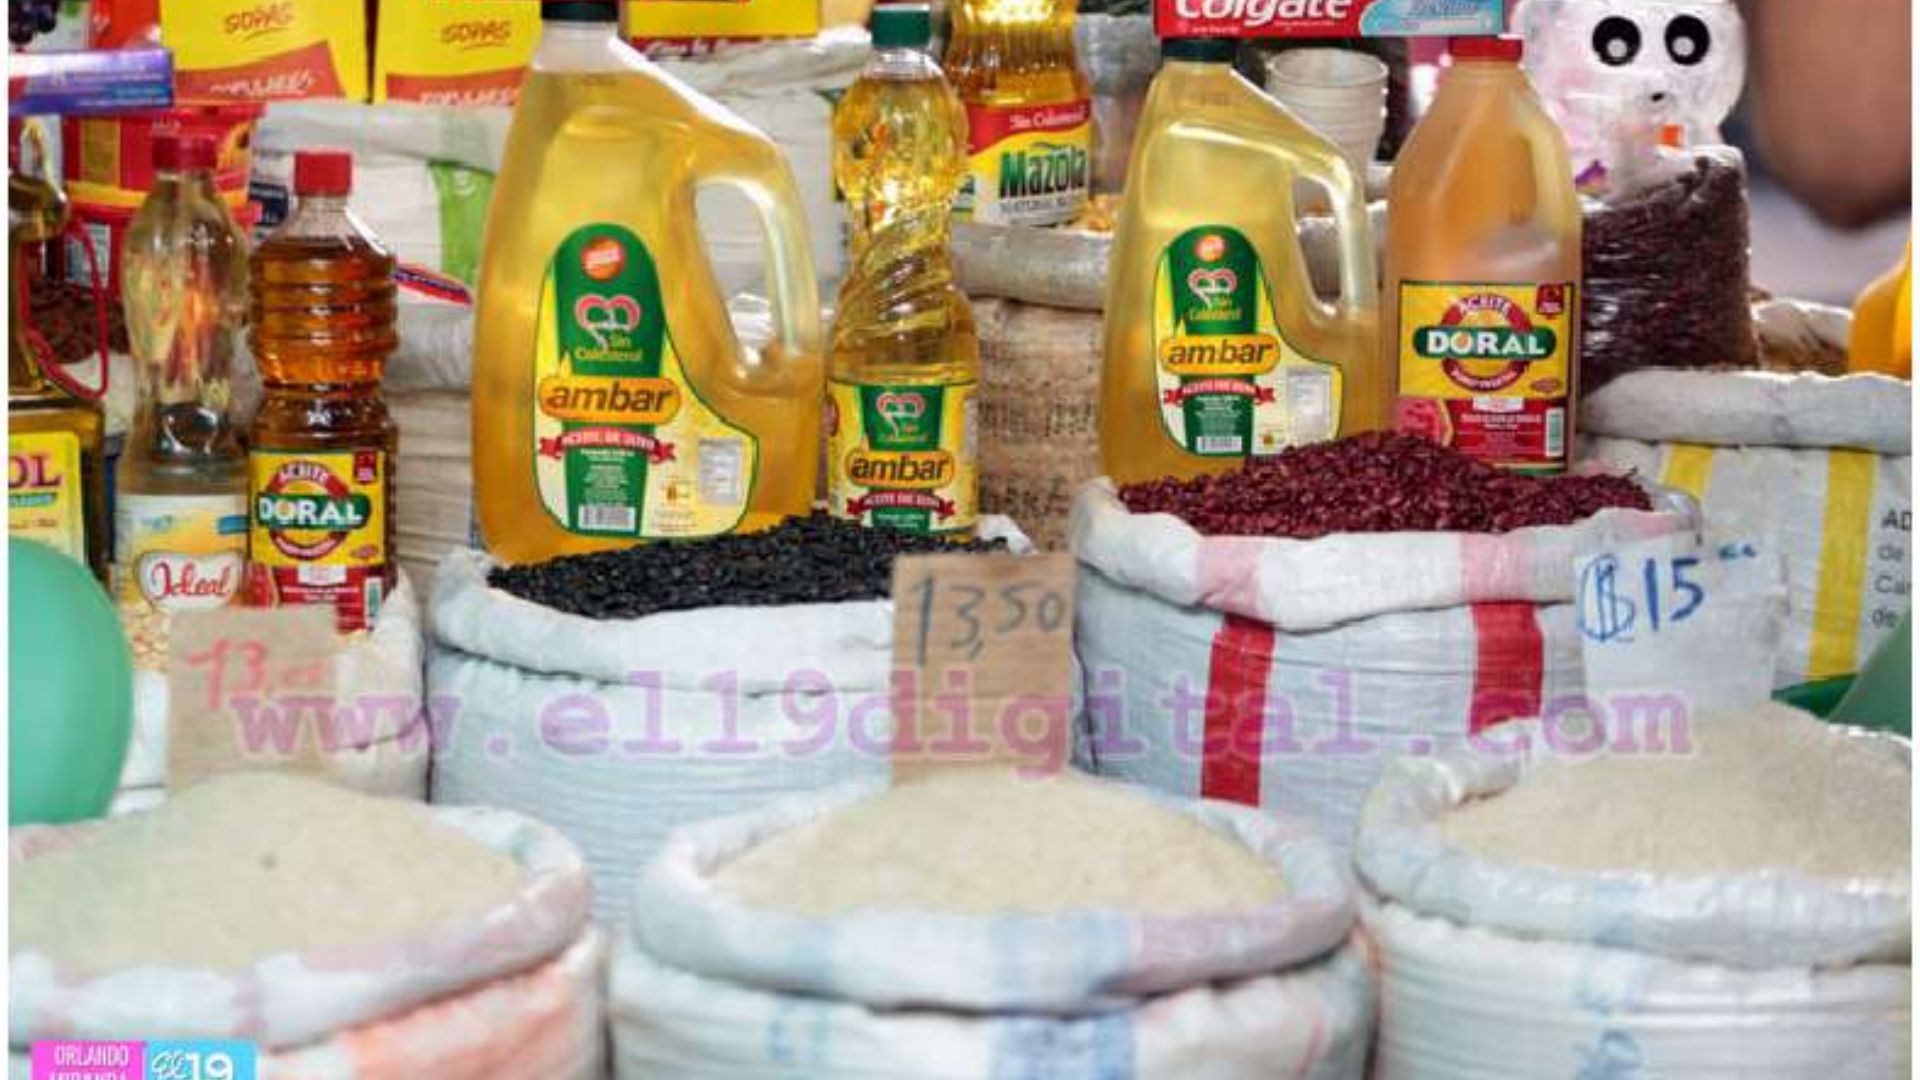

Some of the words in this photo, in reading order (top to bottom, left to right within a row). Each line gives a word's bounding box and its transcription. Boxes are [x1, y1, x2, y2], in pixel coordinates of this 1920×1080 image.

[224, 4, 294, 34] SOPAS
[1174, 0, 1350, 27] Colgate
[440, 20, 511, 43] SOPAS
[1000, 145, 1085, 198] Mazola
[1167, 339, 1273, 365] ambar
[1426, 331, 1546, 355] DORAL
[547, 382, 672, 413] ambar
[850, 454, 950, 480] ambar
[258, 496, 363, 525] DORAL
